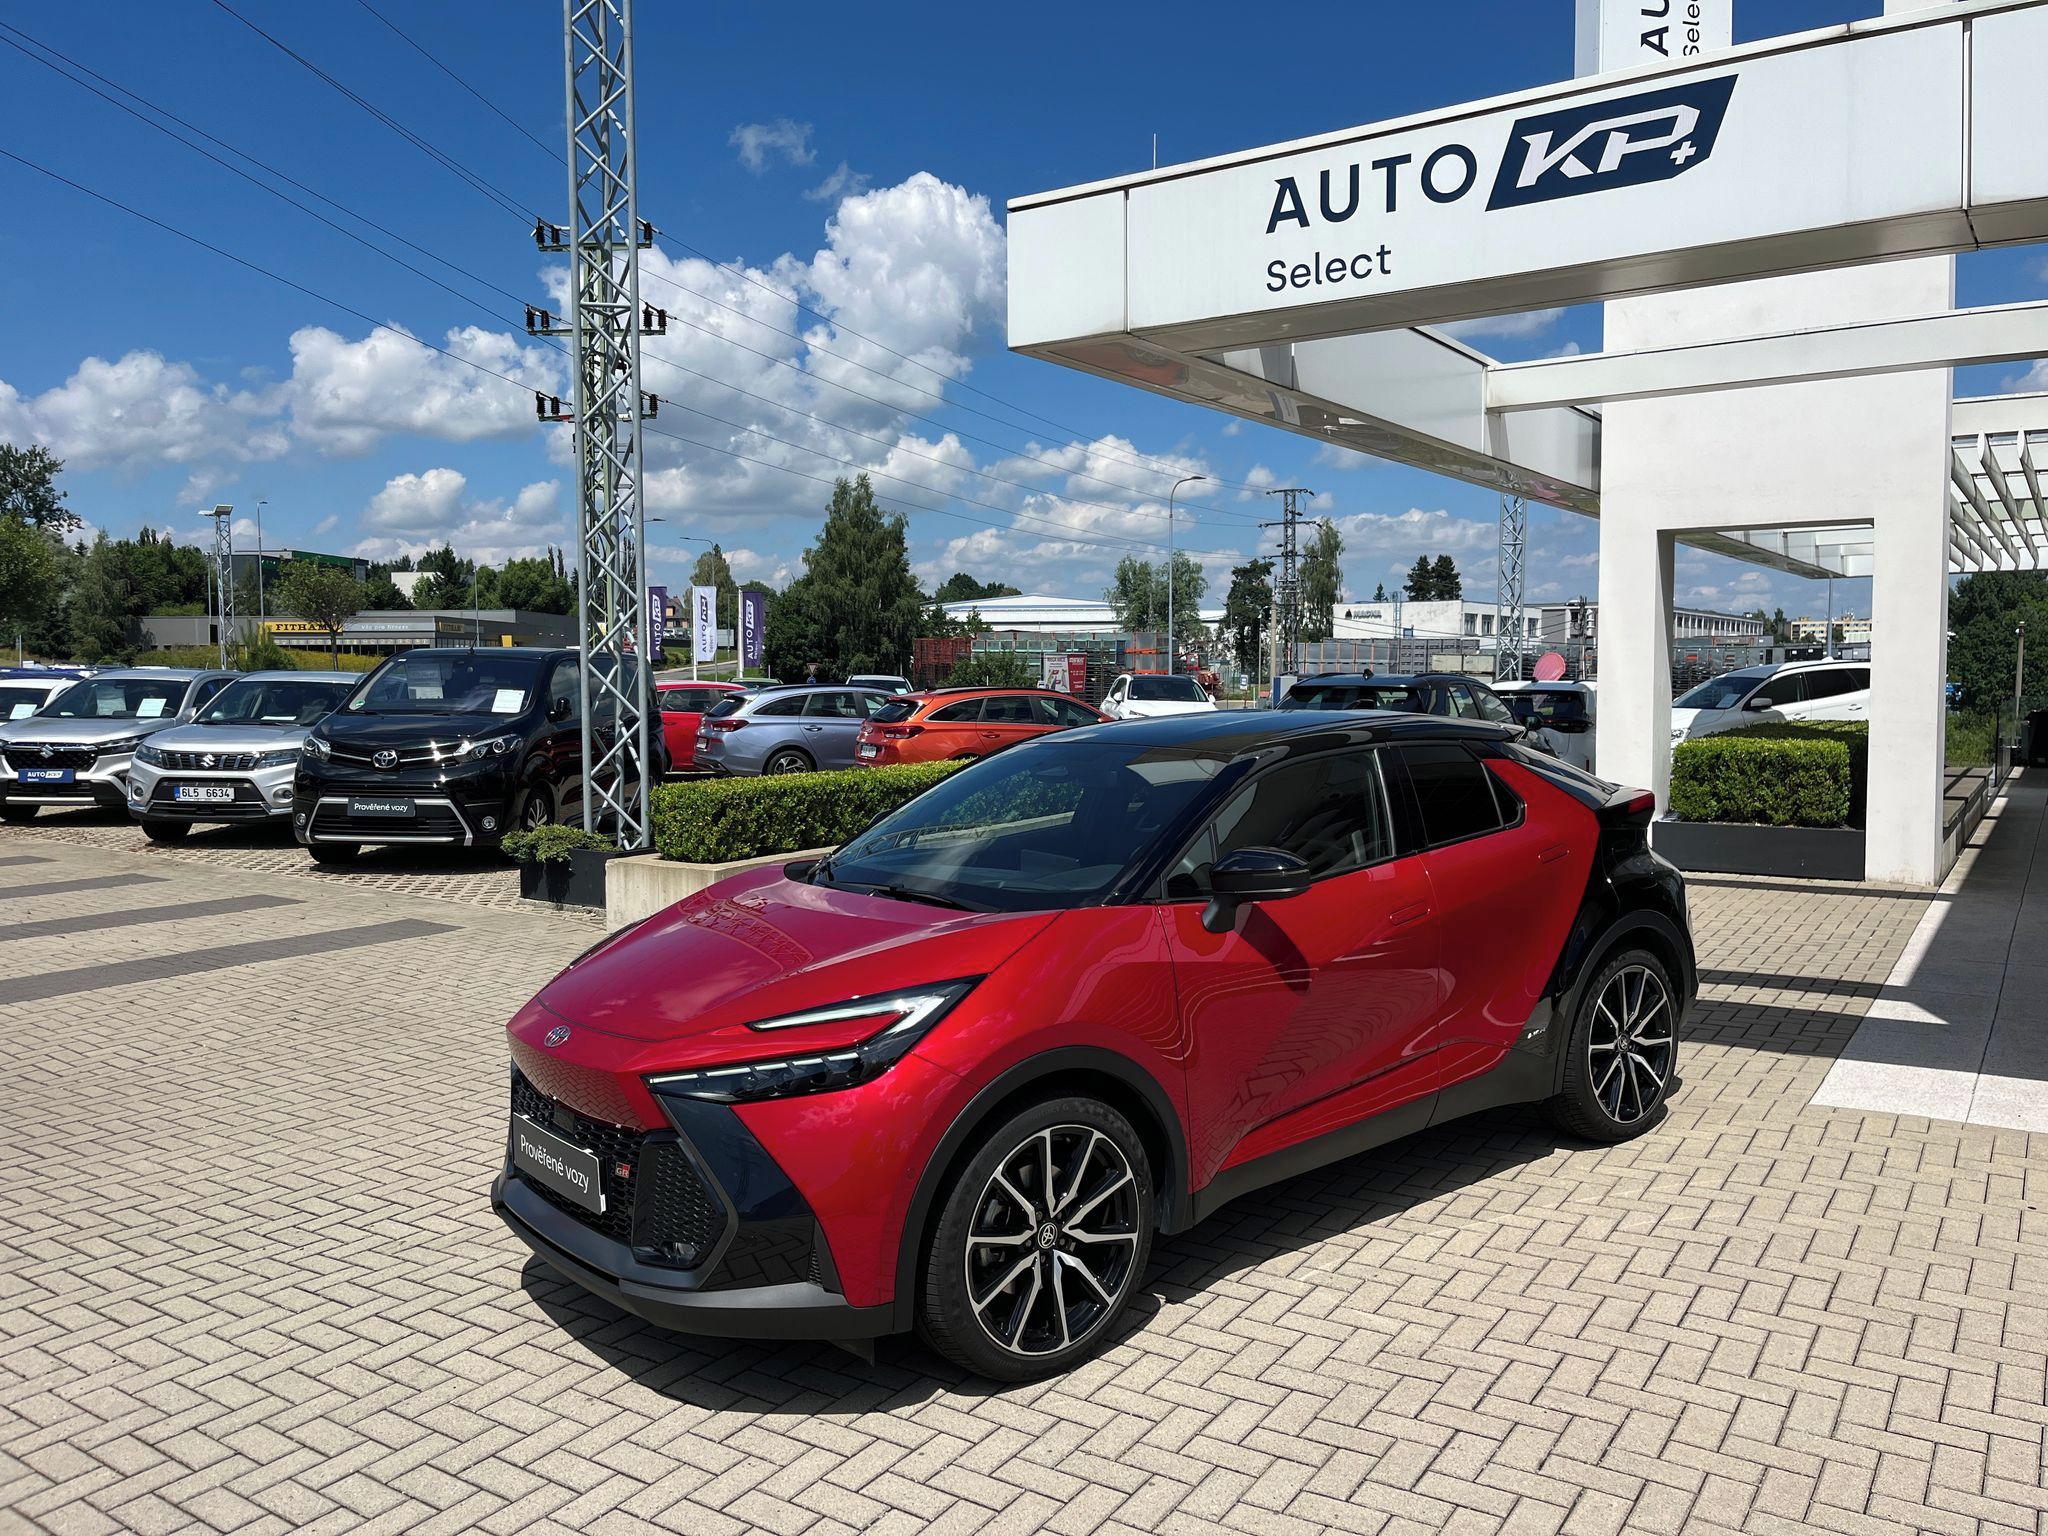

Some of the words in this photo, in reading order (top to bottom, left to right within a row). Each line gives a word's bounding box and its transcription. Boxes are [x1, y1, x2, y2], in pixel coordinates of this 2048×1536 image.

[1683, 0, 1700, 56] Sele
[1265, 143, 1477, 234] AUTO
[1266, 244, 1392, 292] Select
[654, 623, 662, 652] AUTO
[746, 629, 754, 660] AUTO
[181, 787, 199, 798] 6L5
[206, 787, 230, 798] 6634
[354, 802, 390, 811] Prověřené
[391, 804, 408, 812] vozy
[520, 1134, 564, 1176] Prověřené
[565, 1165, 589, 1194] vozy
[616, 1167, 630, 1177] GR
